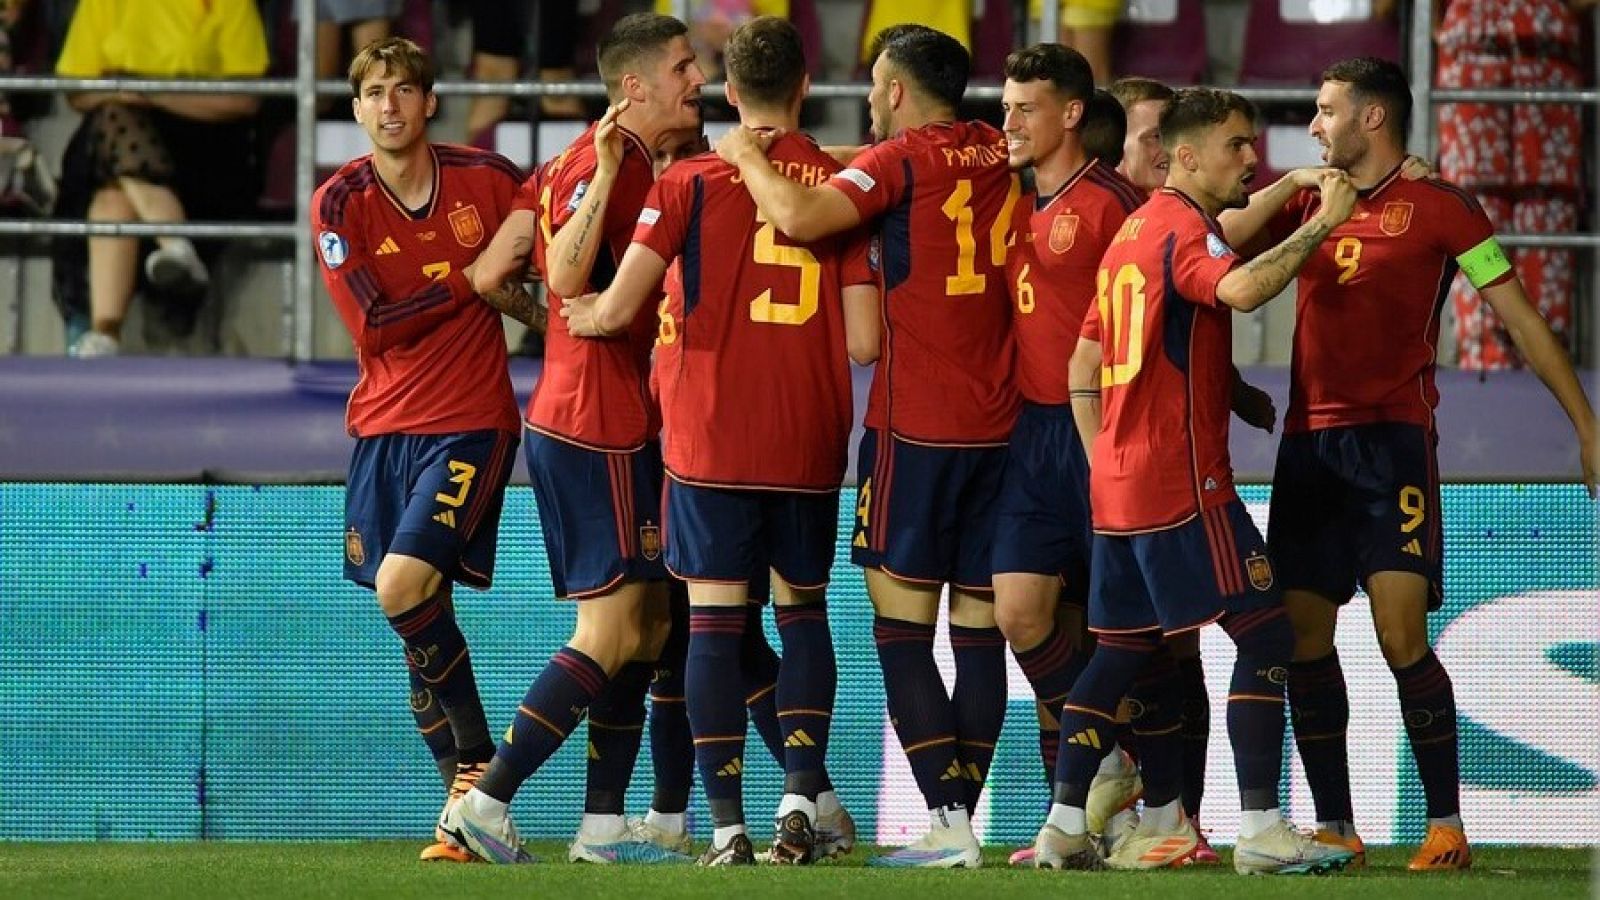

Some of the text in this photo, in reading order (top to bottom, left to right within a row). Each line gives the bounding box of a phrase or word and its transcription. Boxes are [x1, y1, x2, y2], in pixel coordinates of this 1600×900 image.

[941, 172, 1021, 296] 14
[750, 207, 821, 325] 5
[1334, 237, 1363, 285] 9
[1016, 263, 1035, 314] 6
[654, 294, 677, 345] 6
[436, 460, 476, 507] 3
[1399, 485, 1425, 533] 9
